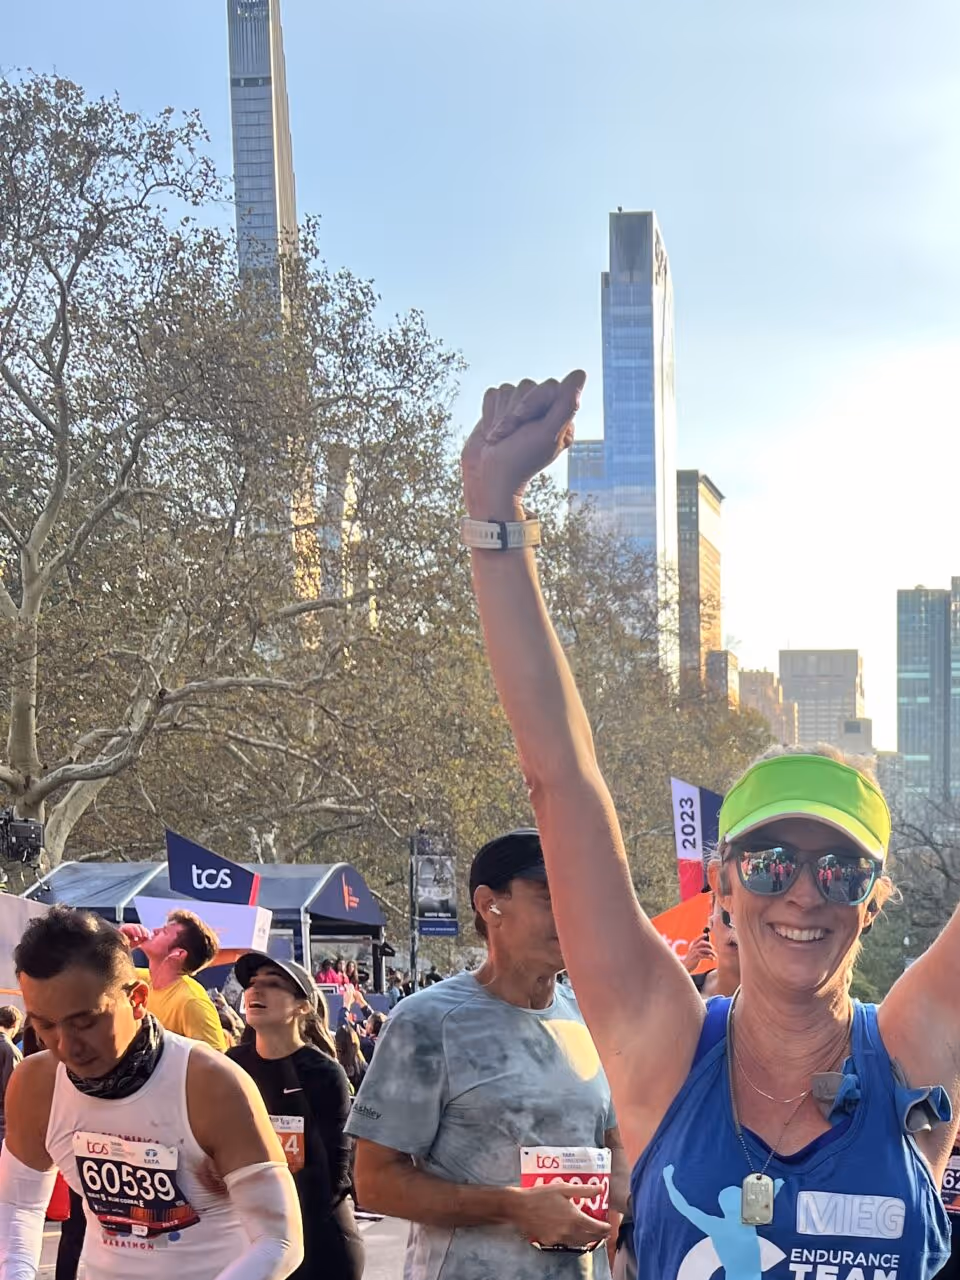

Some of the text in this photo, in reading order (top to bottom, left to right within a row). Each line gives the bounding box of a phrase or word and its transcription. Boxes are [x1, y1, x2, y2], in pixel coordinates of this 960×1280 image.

[679, 797, 696, 850] 2023
[192, 864, 232, 889] tcs
[86, 1140, 109, 1155] tcs
[536, 1152, 560, 1169] tcs
[82, 1160, 176, 1202] 60539
[802, 1193, 905, 1238] MEG
[790, 1248, 900, 1269] ENDURANCE
